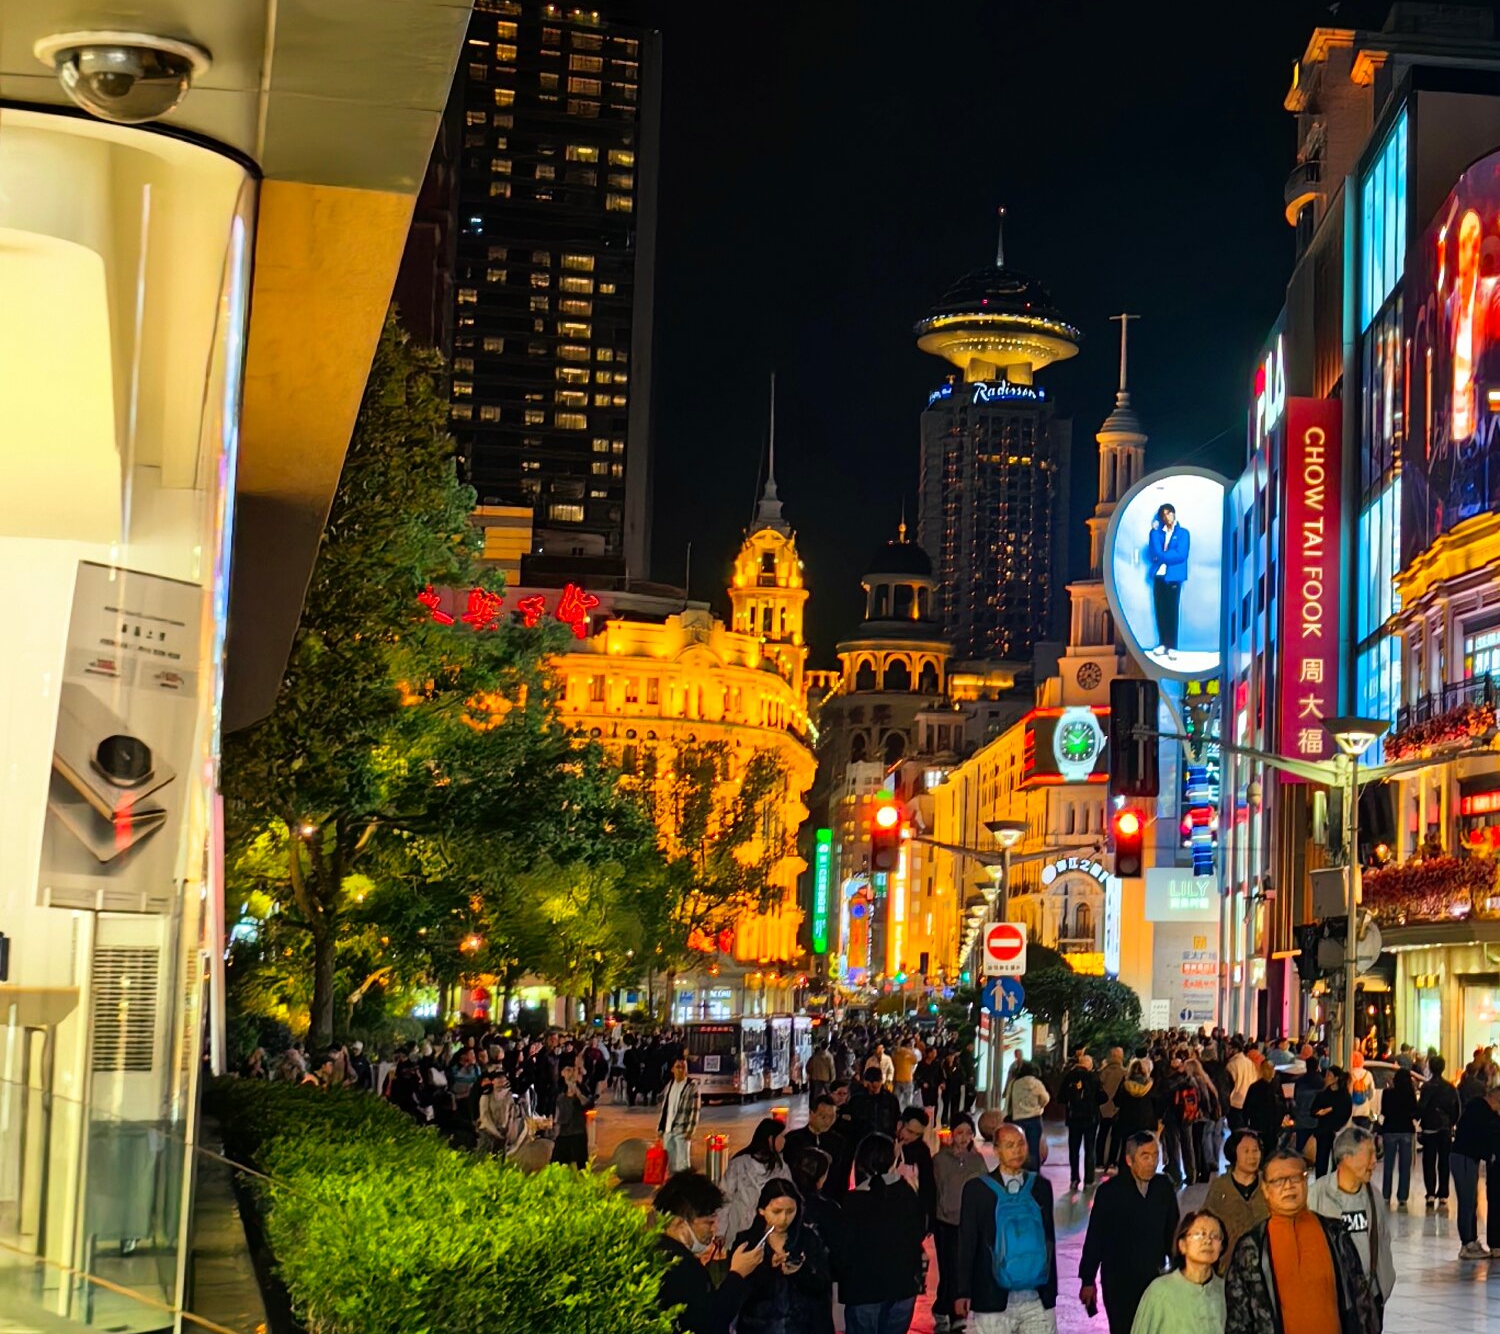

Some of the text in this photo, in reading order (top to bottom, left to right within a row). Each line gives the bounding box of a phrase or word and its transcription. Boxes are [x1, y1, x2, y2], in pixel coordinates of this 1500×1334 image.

[973, 379, 1036, 404] Radisson
[1302, 426, 1325, 638] CHOW TAI FOOK
[1298, 658, 1324, 754] 周大福
[1169, 880, 1210, 897] LILY
